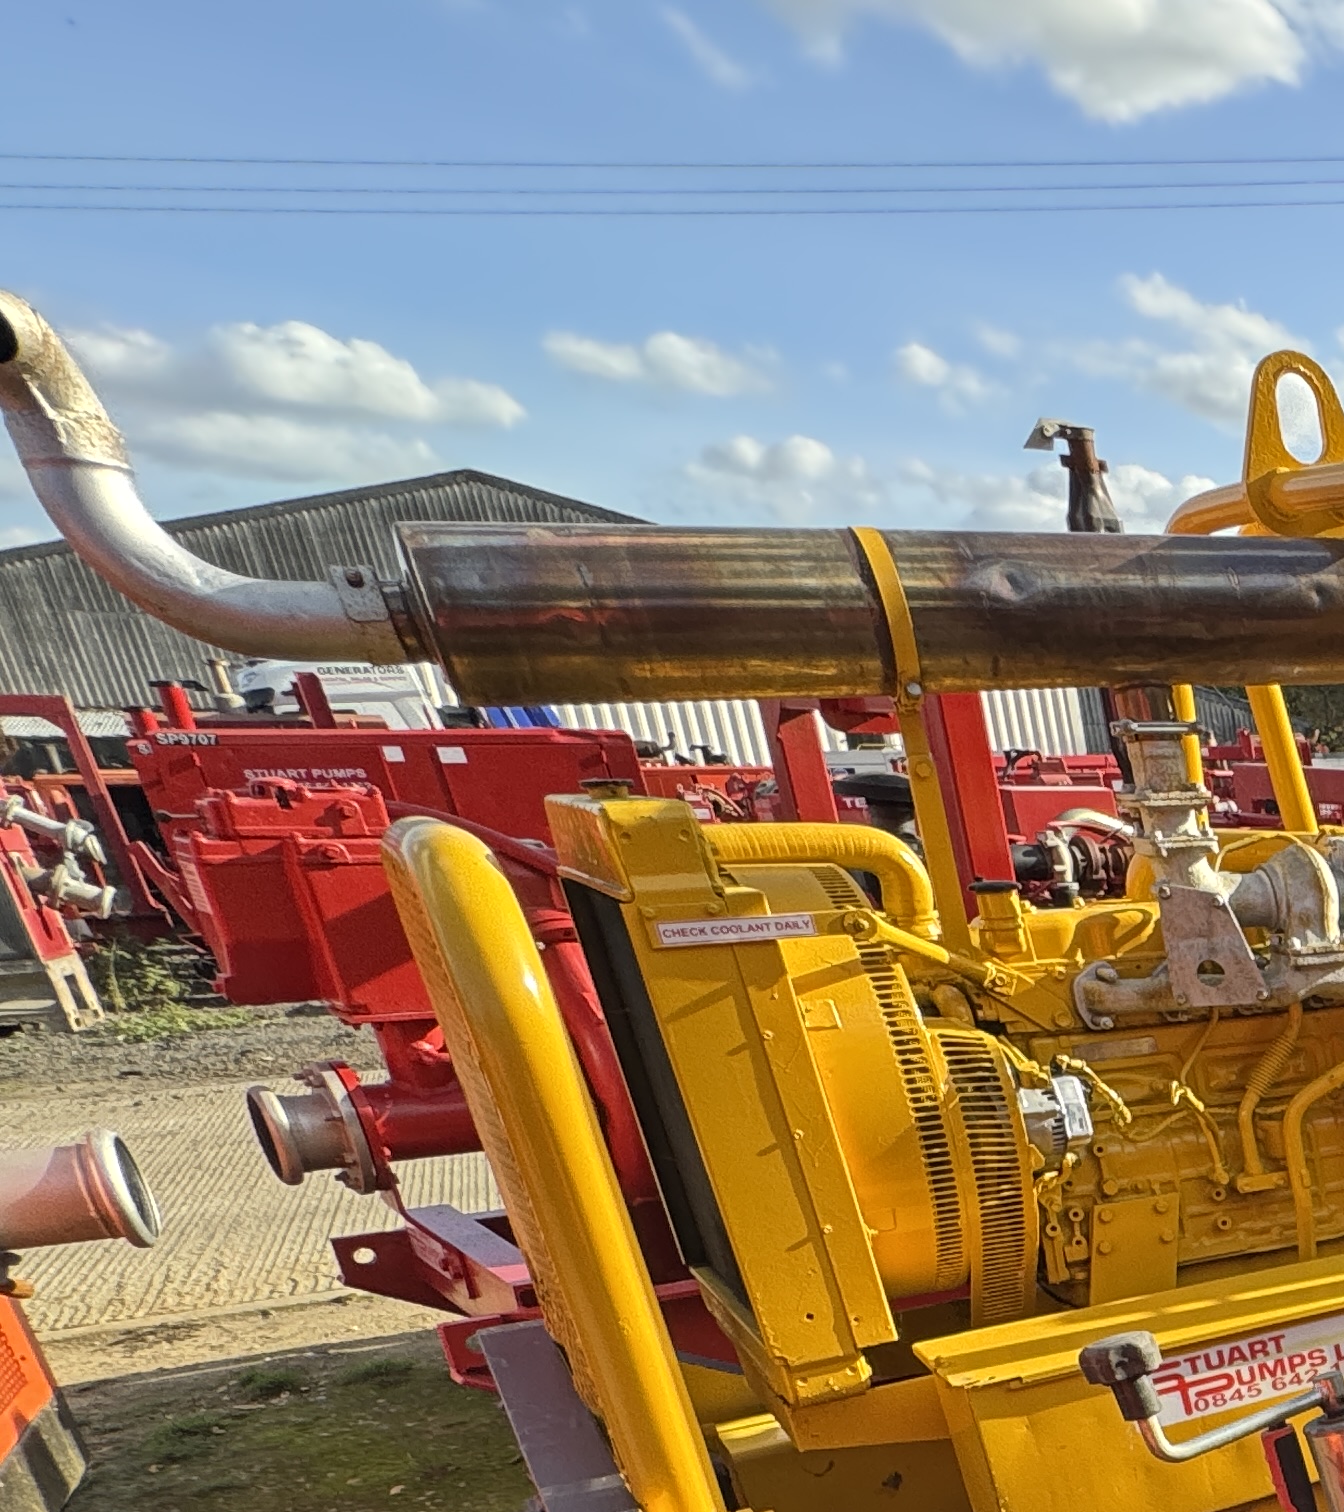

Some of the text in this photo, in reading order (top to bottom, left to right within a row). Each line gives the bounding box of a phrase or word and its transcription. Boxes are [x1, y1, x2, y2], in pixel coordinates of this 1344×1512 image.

[317, 665, 405, 676] GENERATORS
[155, 732, 217, 746] SP9707
[244, 768, 367, 780] STUART PUMPS
[662, 919, 811, 939] CHECK COOLANT DAILY
[1151, 1334, 1285, 1385] STUART
[1157, 1348, 1327, 1416] PUMPS
[1193, 1383, 1263, 1412] 0845
[1271, 1368, 1319, 1392] 642
